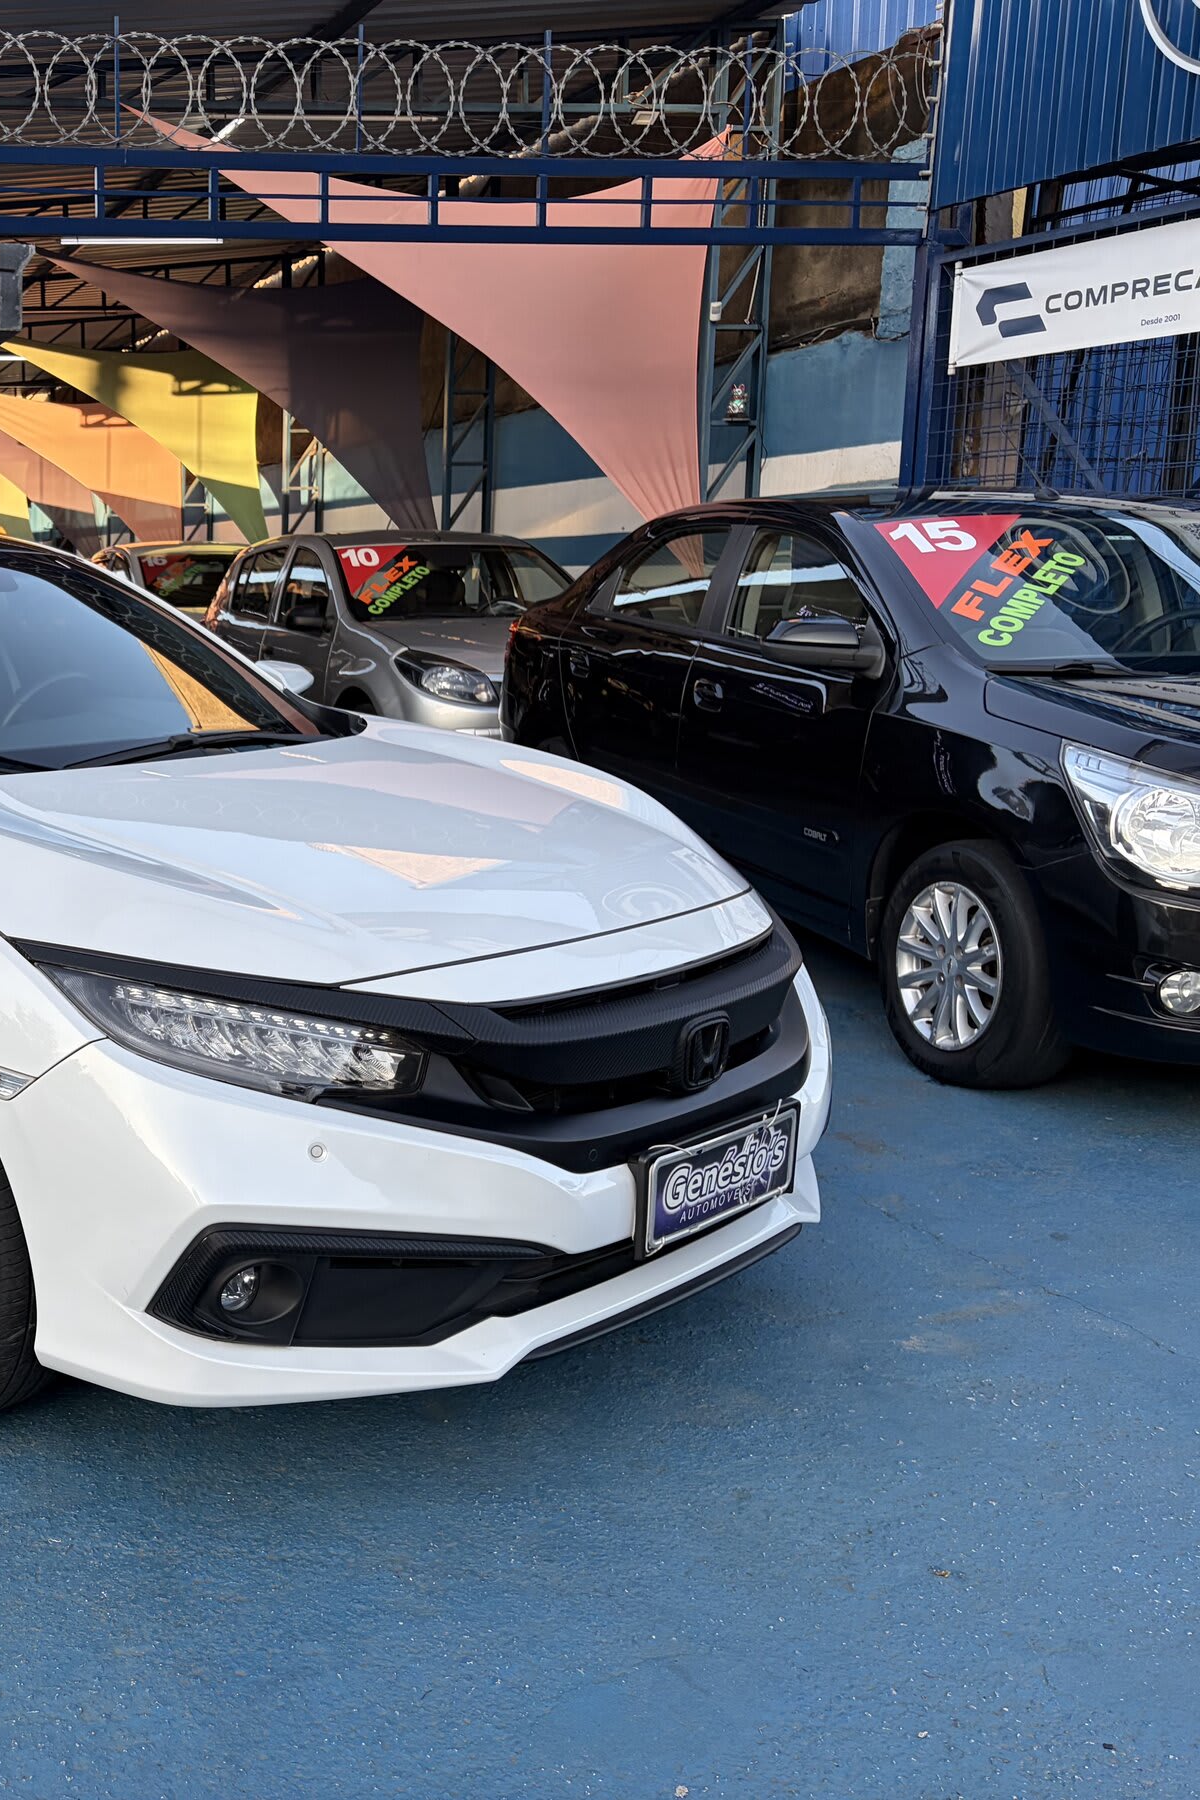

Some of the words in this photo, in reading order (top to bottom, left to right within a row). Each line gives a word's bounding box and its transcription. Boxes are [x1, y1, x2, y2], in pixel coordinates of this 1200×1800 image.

[1045, 268, 1200, 314] COMPREC
[1141, 316, 1163, 327] Desde
[1164, 313, 1181, 323] 2001
[341, 548, 380, 567] 10
[889, 520, 977, 553] 15
[141, 556, 168, 567] 16
[358, 555, 418, 605] FLEX
[950, 529, 1054, 622] FLEX
[368, 566, 431, 615] COMPLETO
[978, 551, 1085, 647] COMPLETO
[664, 1132, 788, 1213] Genésio's
